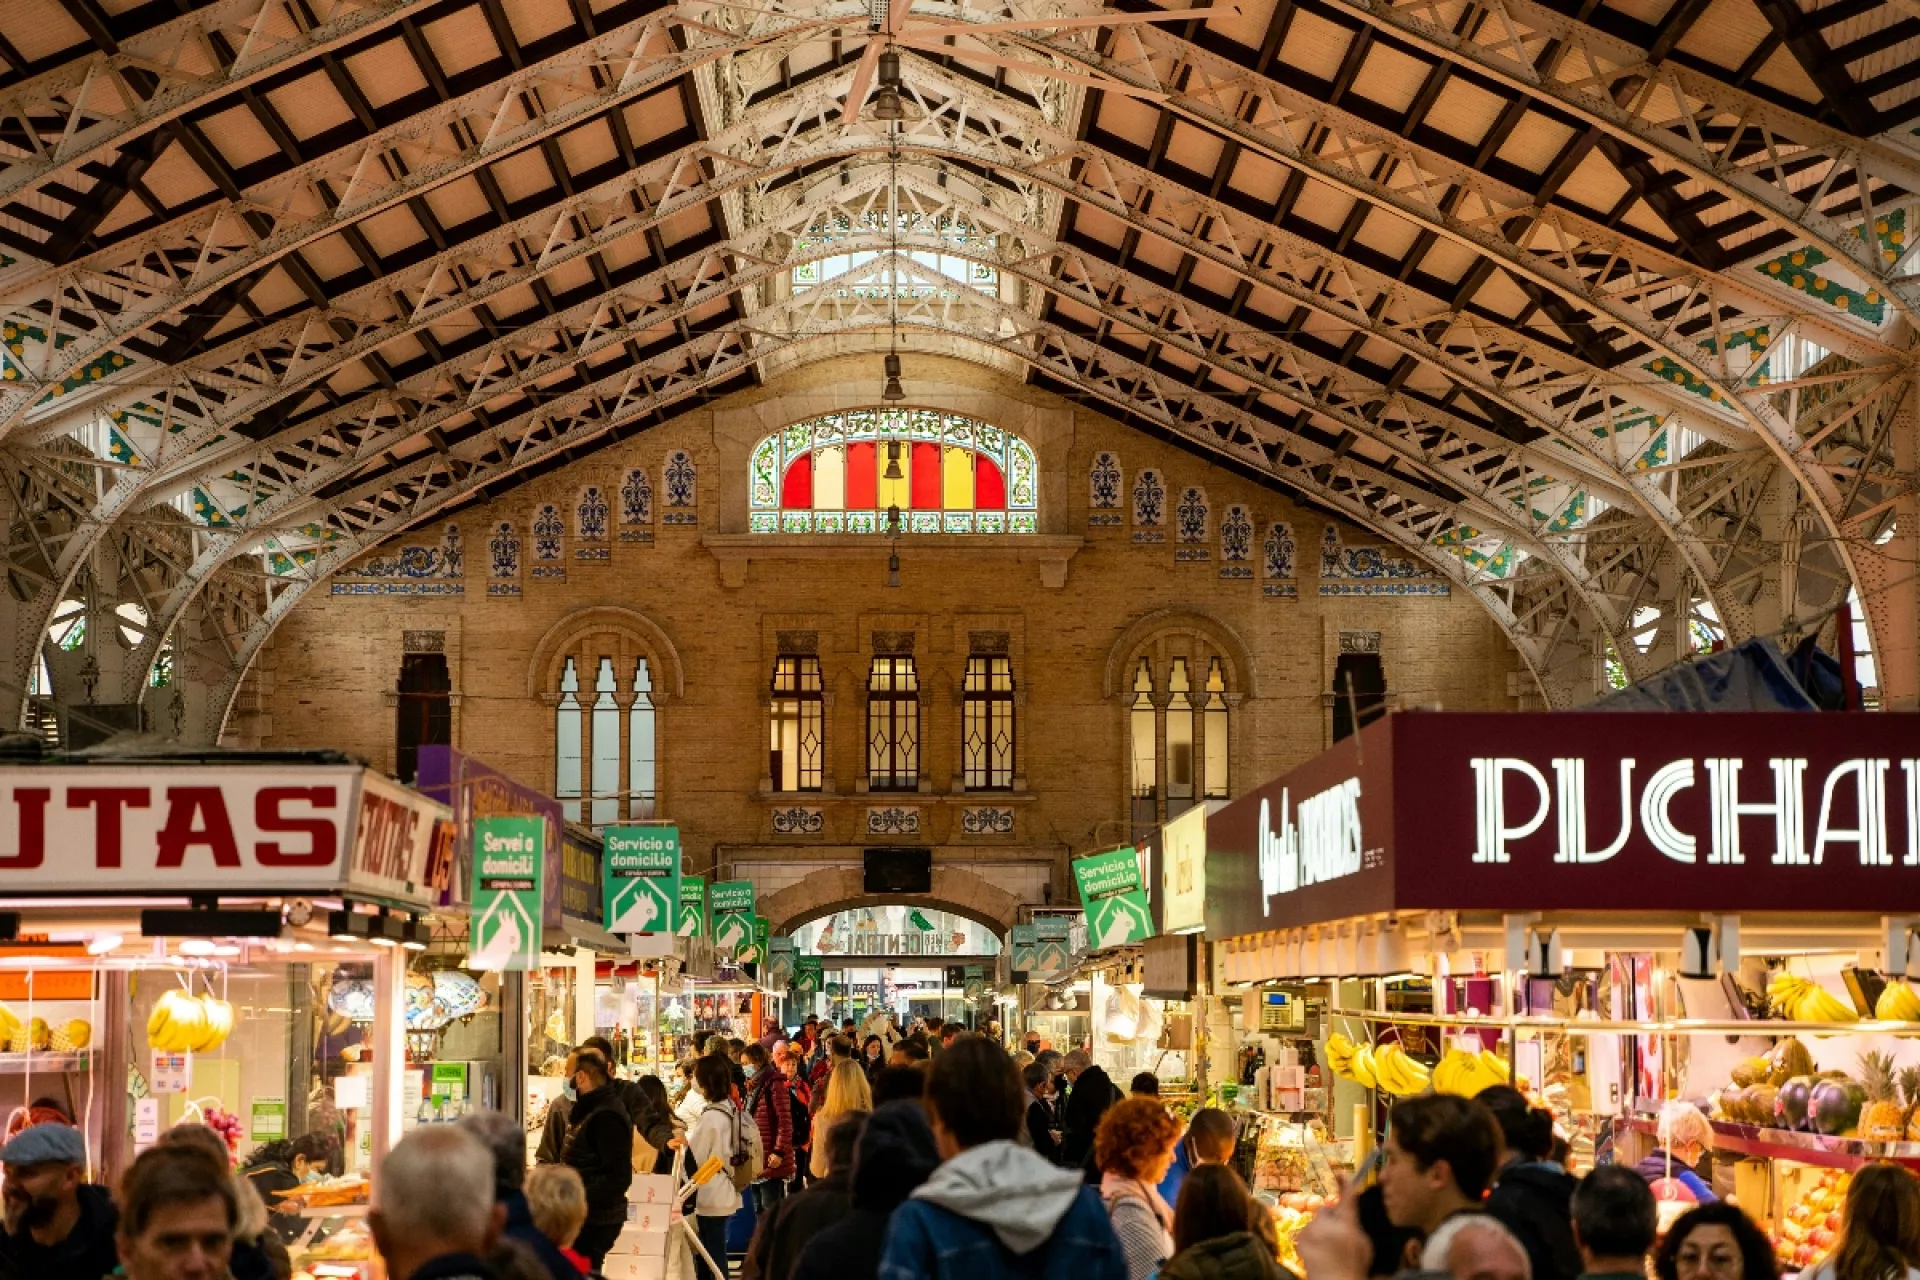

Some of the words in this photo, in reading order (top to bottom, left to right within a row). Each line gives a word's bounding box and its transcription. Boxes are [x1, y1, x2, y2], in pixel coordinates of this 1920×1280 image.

[1469, 757, 1920, 865] PUCHA
[483, 832, 522, 852] Servei
[525, 837, 534, 852] a
[609, 836, 663, 851] Servicio
[665, 839, 675, 851] a
[483, 854, 534, 875] domicili
[610, 852, 673, 867] domicilio
[1078, 859, 1126, 880] Servicio
[1127, 858, 1135, 868] a
[1084, 871, 1137, 894] domicilio
[711, 888, 745, 899] Servicio
[713, 898, 751, 909] domicilio
